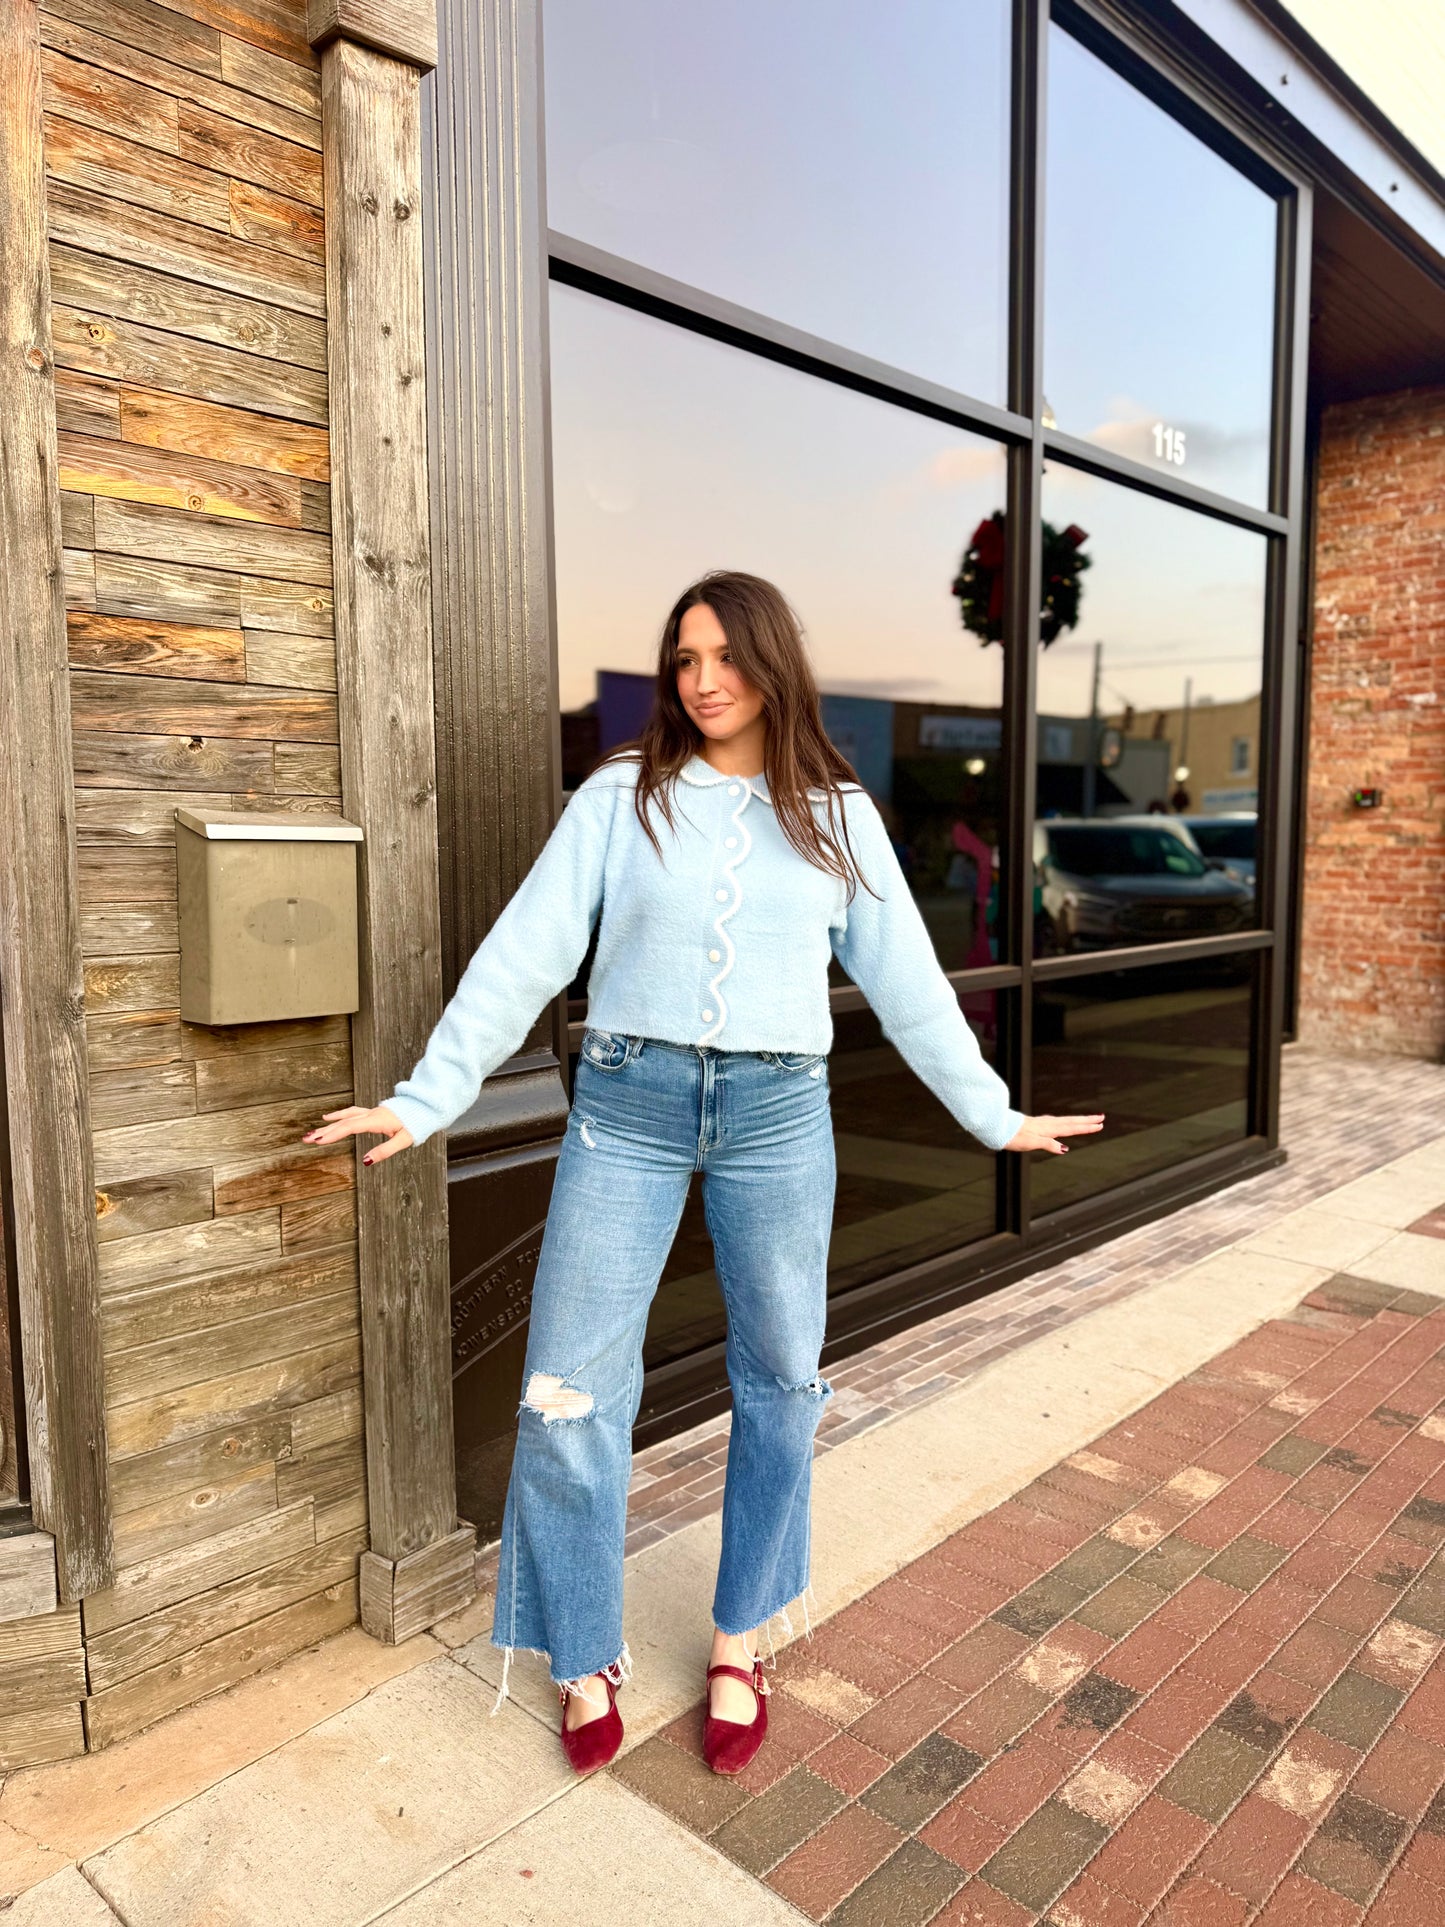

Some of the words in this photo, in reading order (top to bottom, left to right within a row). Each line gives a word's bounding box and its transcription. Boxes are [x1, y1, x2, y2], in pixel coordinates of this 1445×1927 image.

[1152, 422, 1186, 465] 115
[451, 1265, 508, 1338] SOUTHERN
[459, 1289, 533, 1356] OWENSBOR
